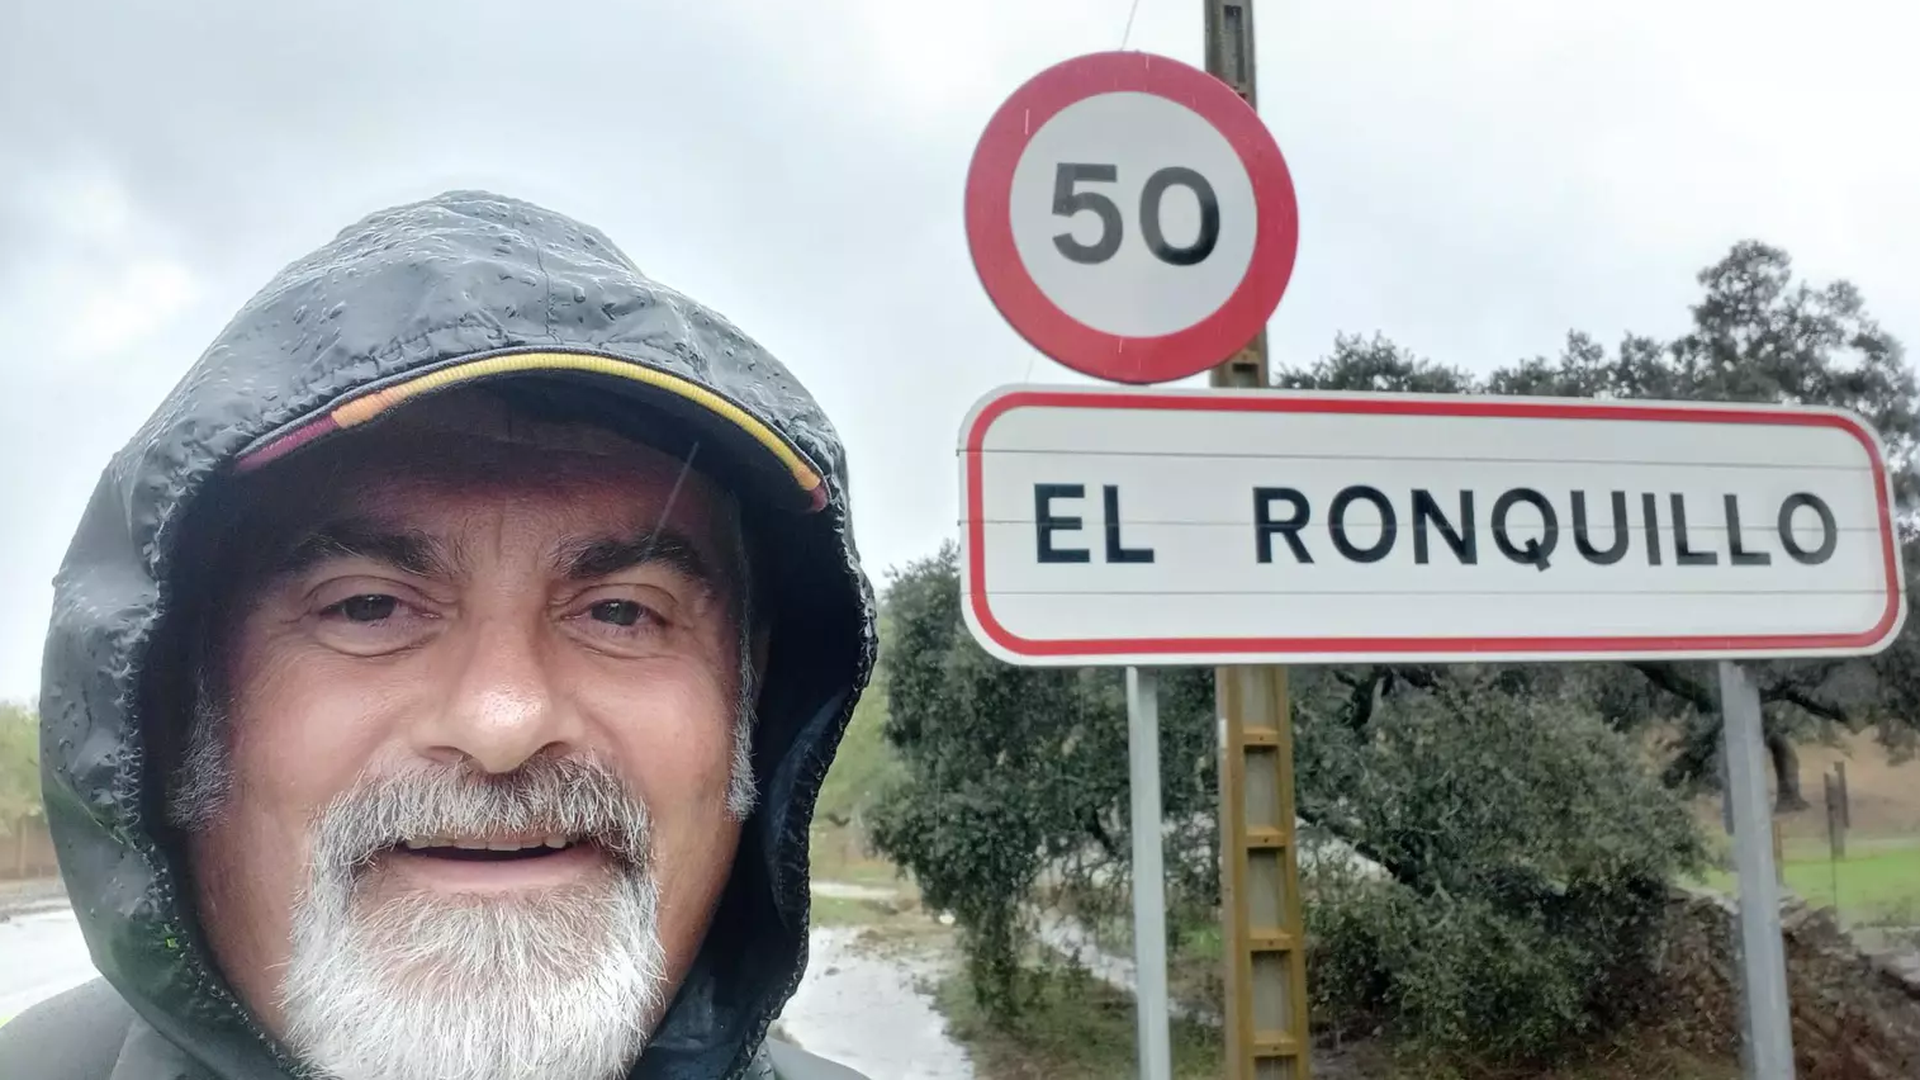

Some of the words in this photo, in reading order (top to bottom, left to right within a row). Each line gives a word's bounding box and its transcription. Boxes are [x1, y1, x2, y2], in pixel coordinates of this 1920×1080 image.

[1052, 163, 1221, 267] 50
[1034, 484, 1154, 564] EL
[1253, 485, 1838, 571] RONQUILLO
